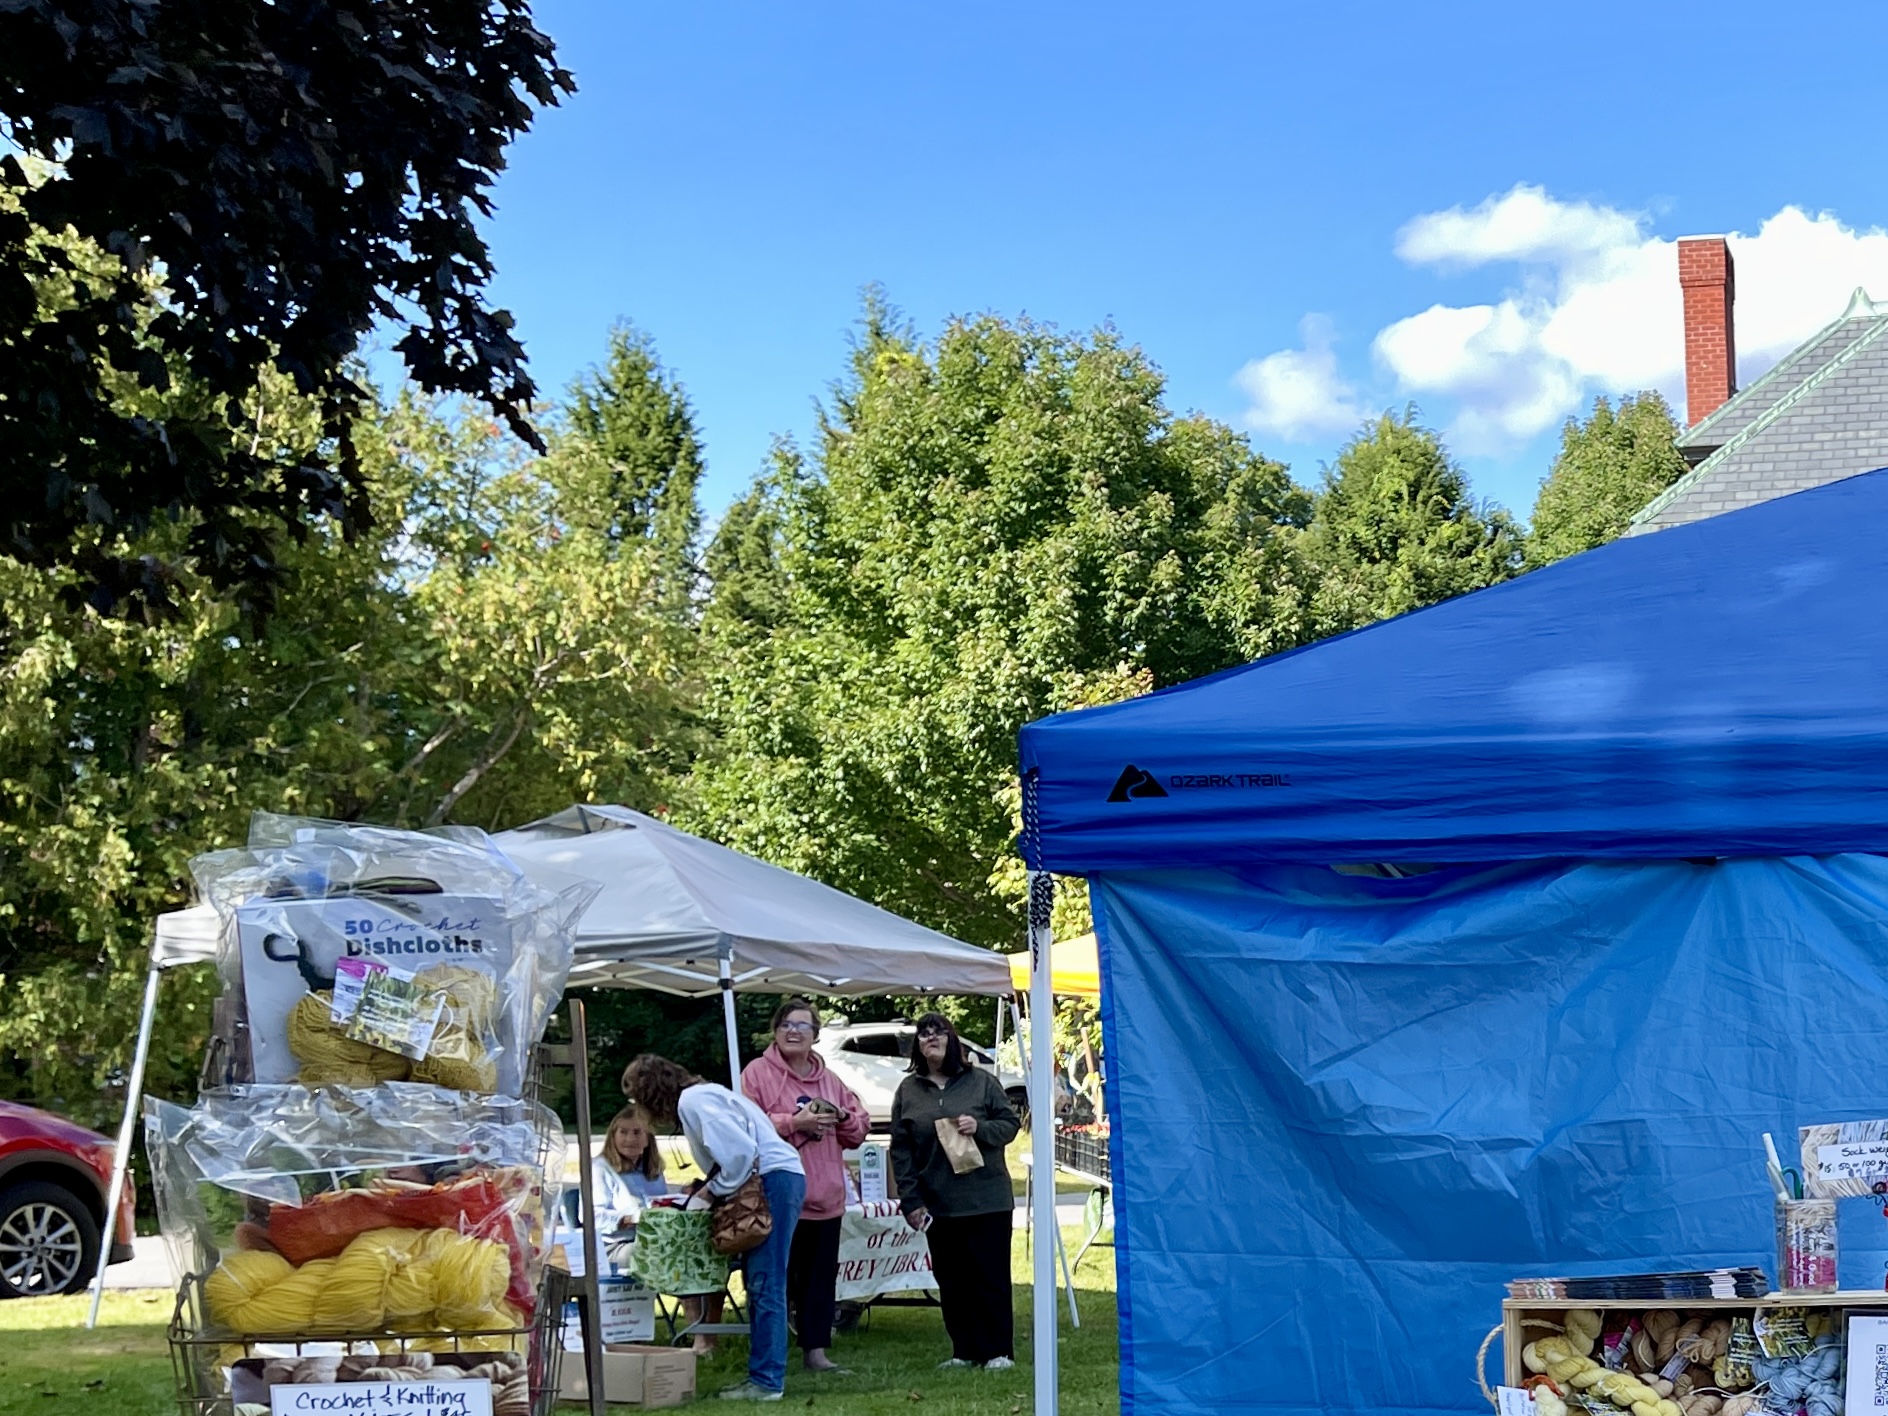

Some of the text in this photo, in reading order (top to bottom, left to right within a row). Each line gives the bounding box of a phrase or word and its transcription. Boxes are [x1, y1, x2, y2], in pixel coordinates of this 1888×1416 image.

[345, 919, 374, 935] 50
[346, 935, 484, 957] Dishcloths
[1841, 1146, 1867, 1157] Sock
[1861, 1159, 1876, 1168] 100
[890, 1225, 917, 1248] the
[296, 1389, 373, 1410] Crochet
[397, 1385, 466, 1412] Knitting
